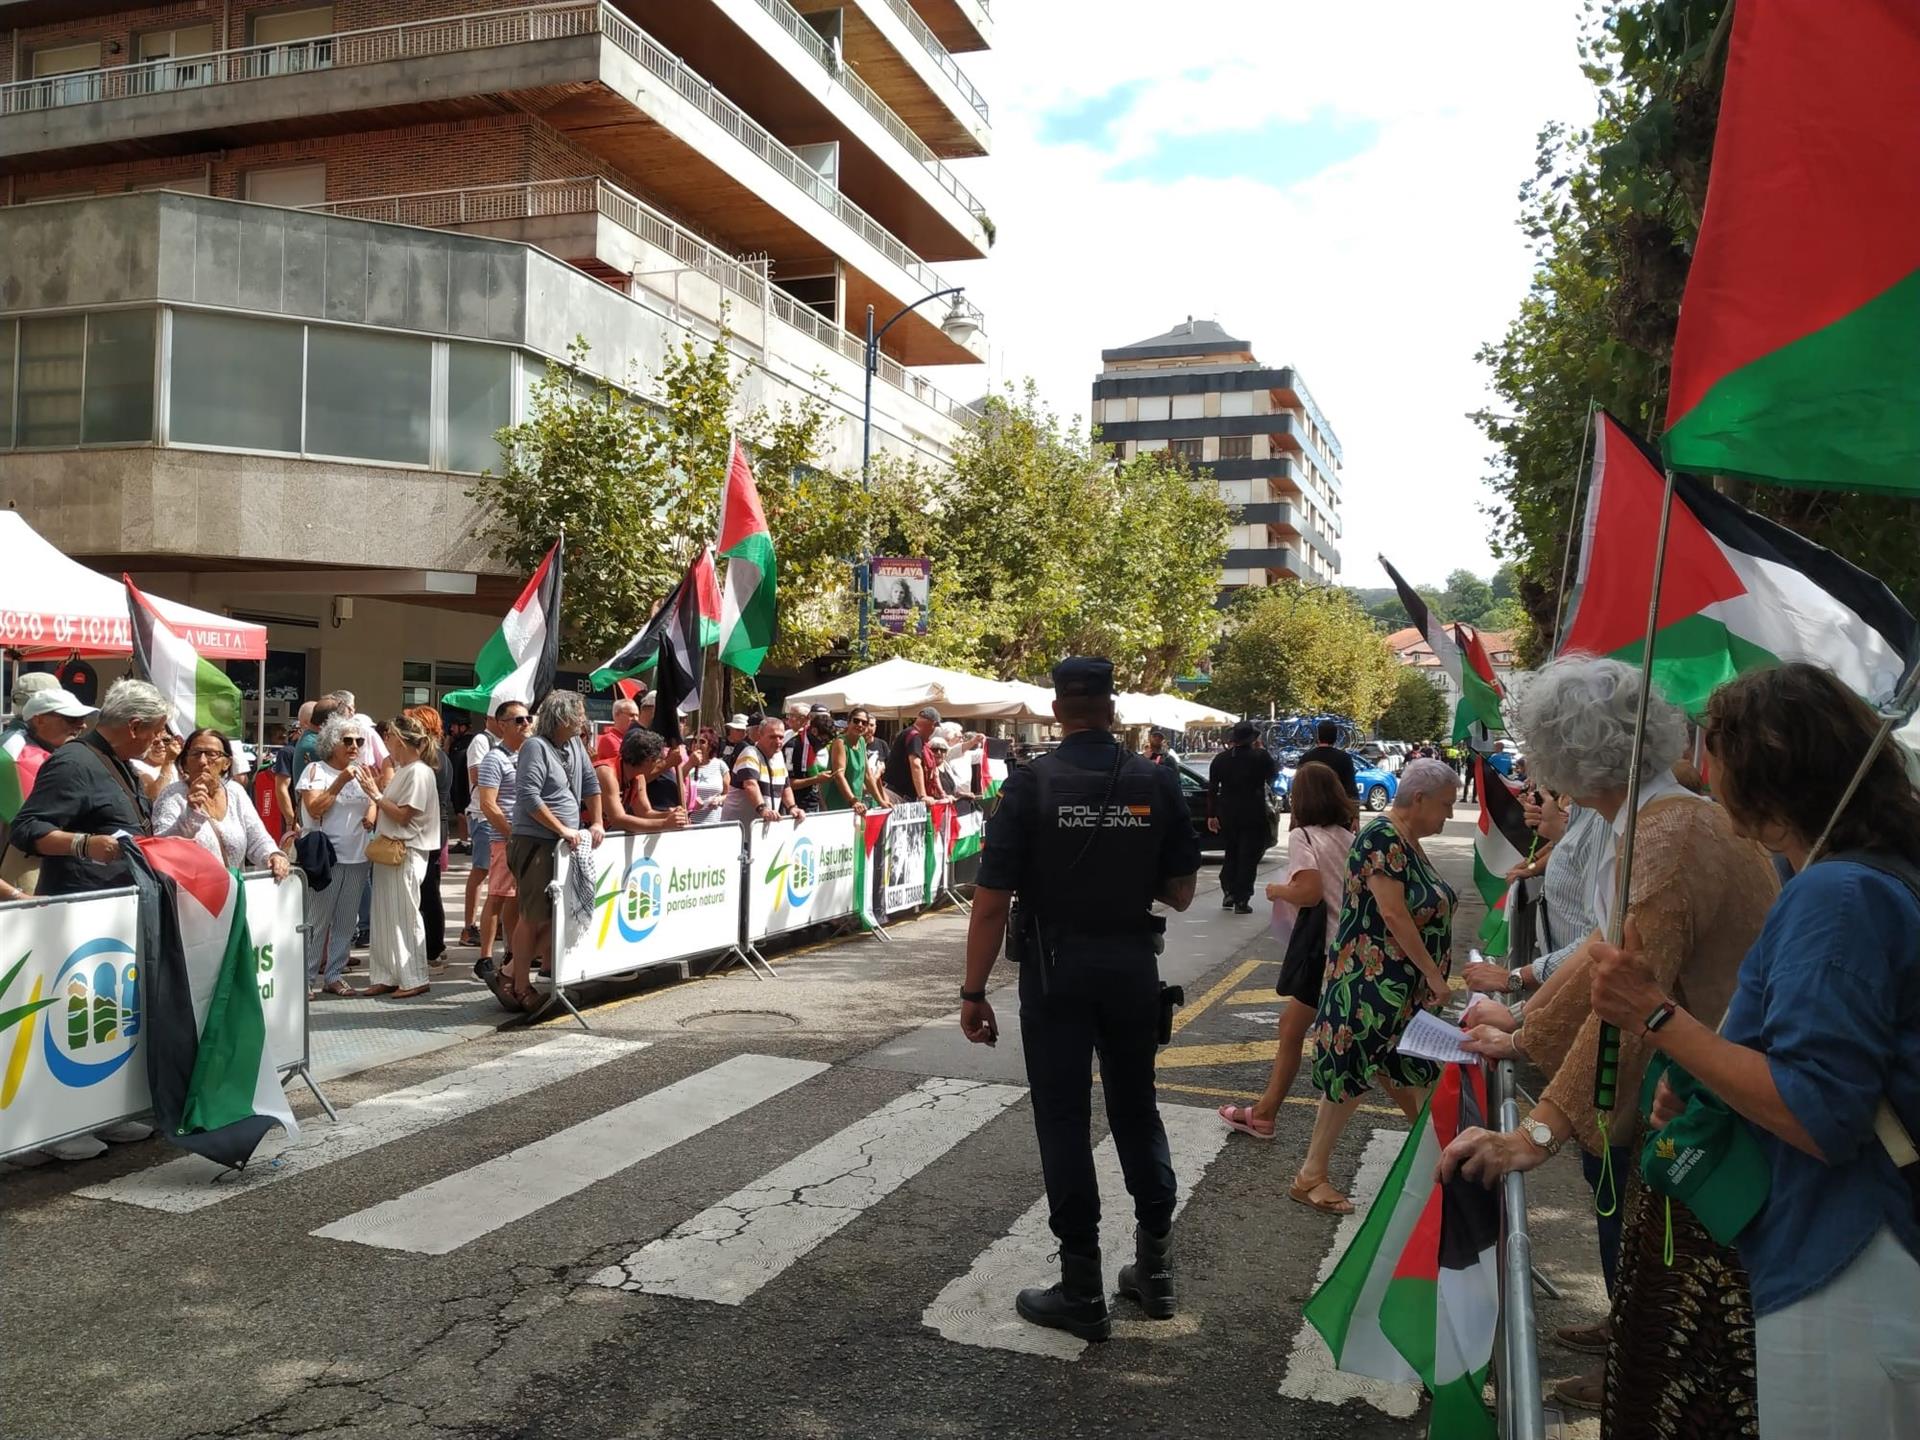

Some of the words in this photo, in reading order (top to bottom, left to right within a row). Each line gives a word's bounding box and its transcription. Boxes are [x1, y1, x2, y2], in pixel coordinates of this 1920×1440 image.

[879, 567, 924, 577] ATALAYA
[53, 613, 133, 646] OFICIAL
[196, 630, 242, 649] VUELTA
[1058, 816, 1151, 828] NACONAL
[818, 843, 853, 867] Asturias
[668, 864, 726, 894] Asturias
[666, 894, 698, 916] paraíso
[699, 889, 726, 906] natural
